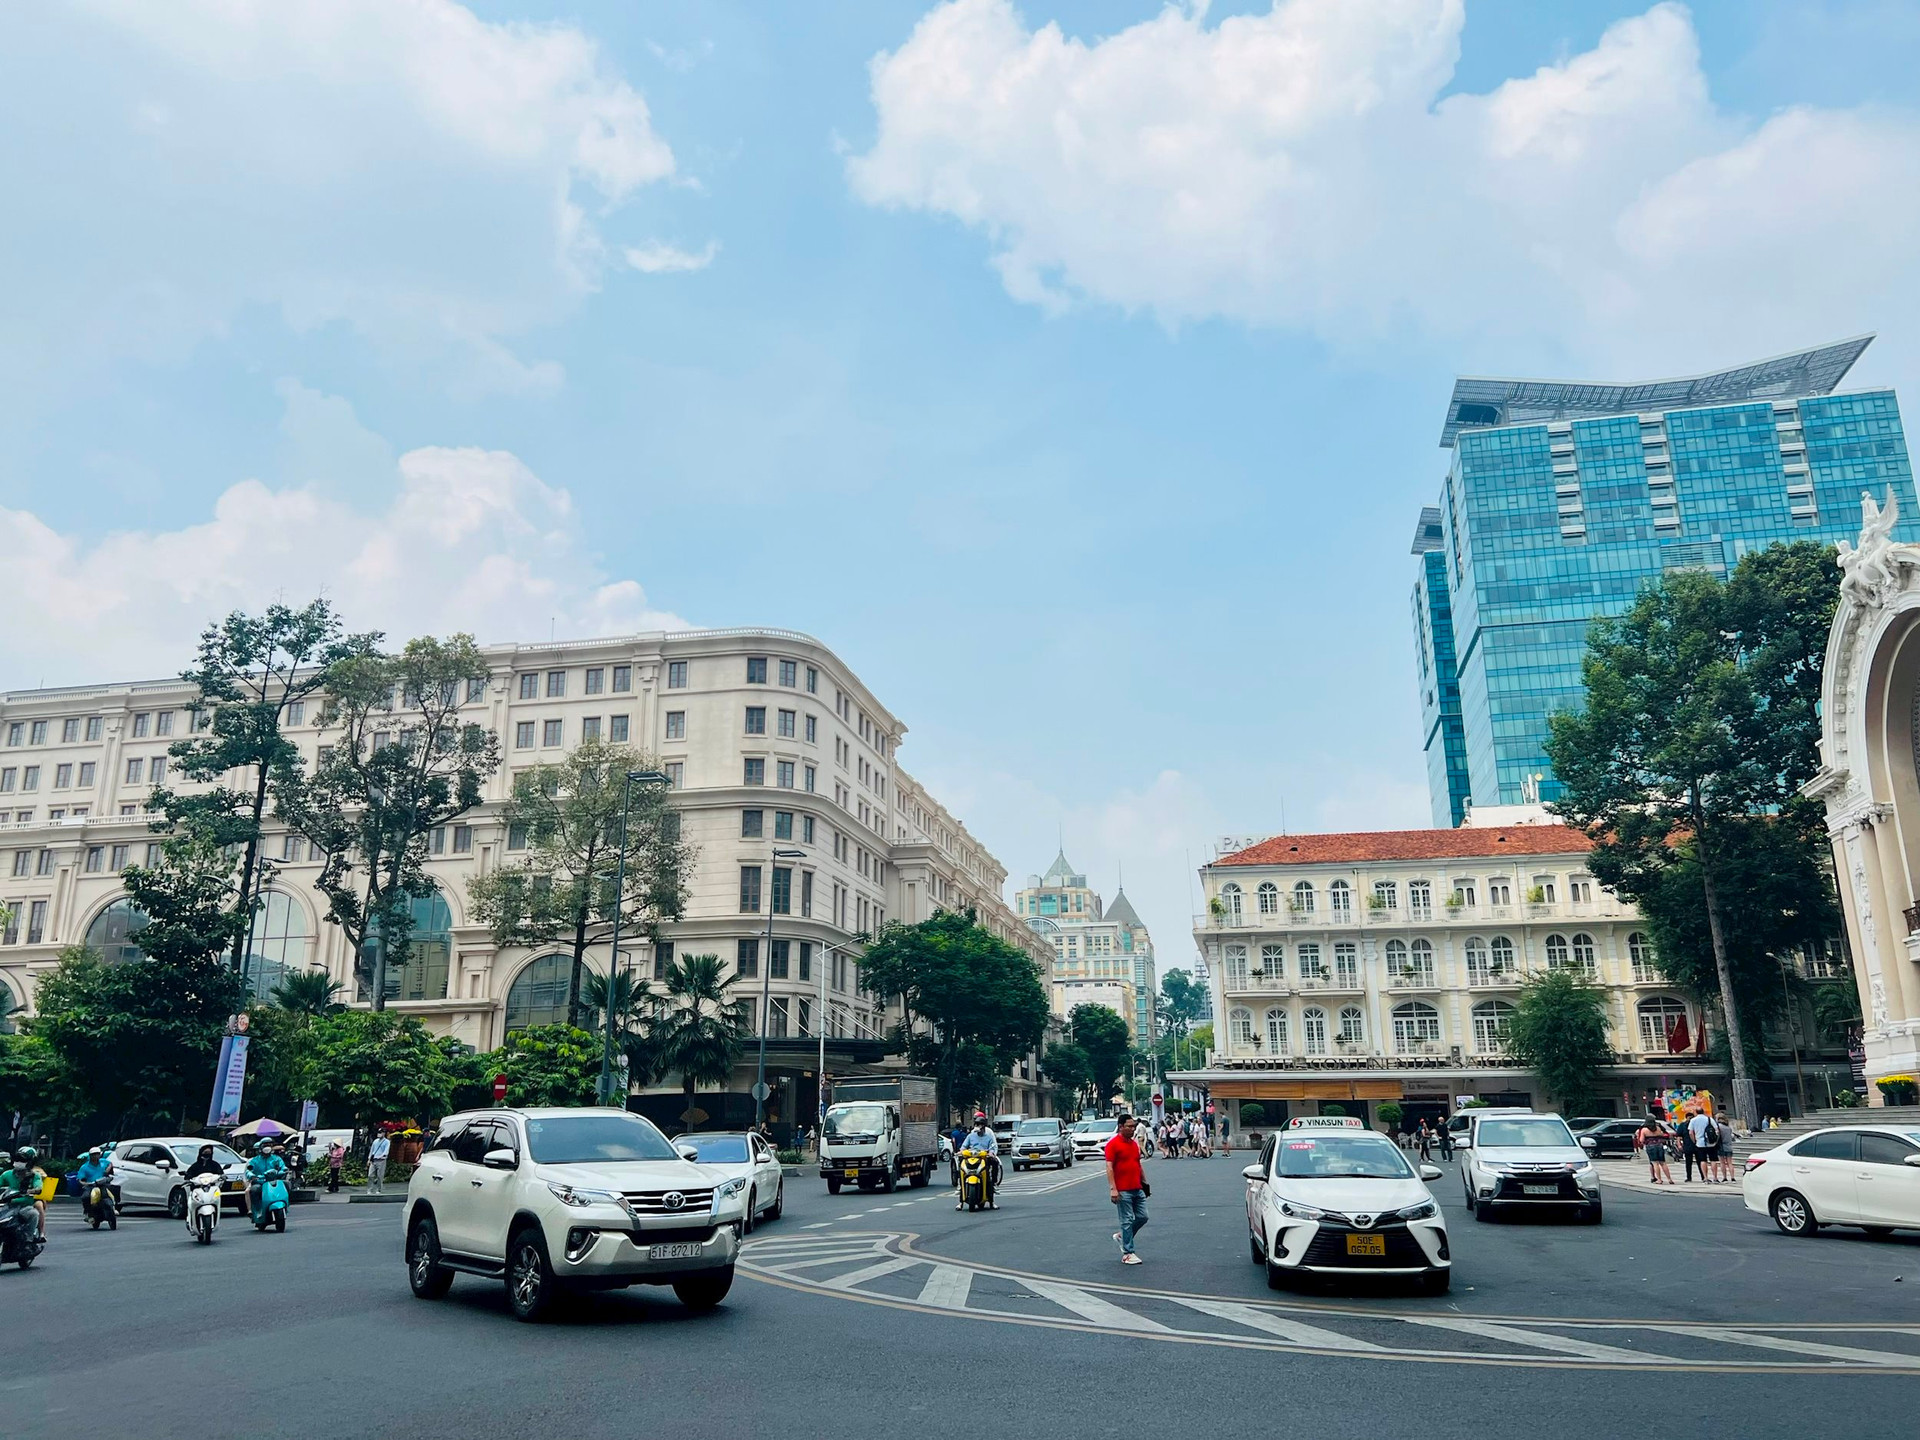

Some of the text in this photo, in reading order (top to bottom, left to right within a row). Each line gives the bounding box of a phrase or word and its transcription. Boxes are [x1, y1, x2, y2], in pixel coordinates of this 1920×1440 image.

[1310, 1057, 1446, 1070] CONTINENTAL
[1306, 1118, 1361, 1127] VINASUN TAXI
[1357, 1236, 1374, 1245] 50E
